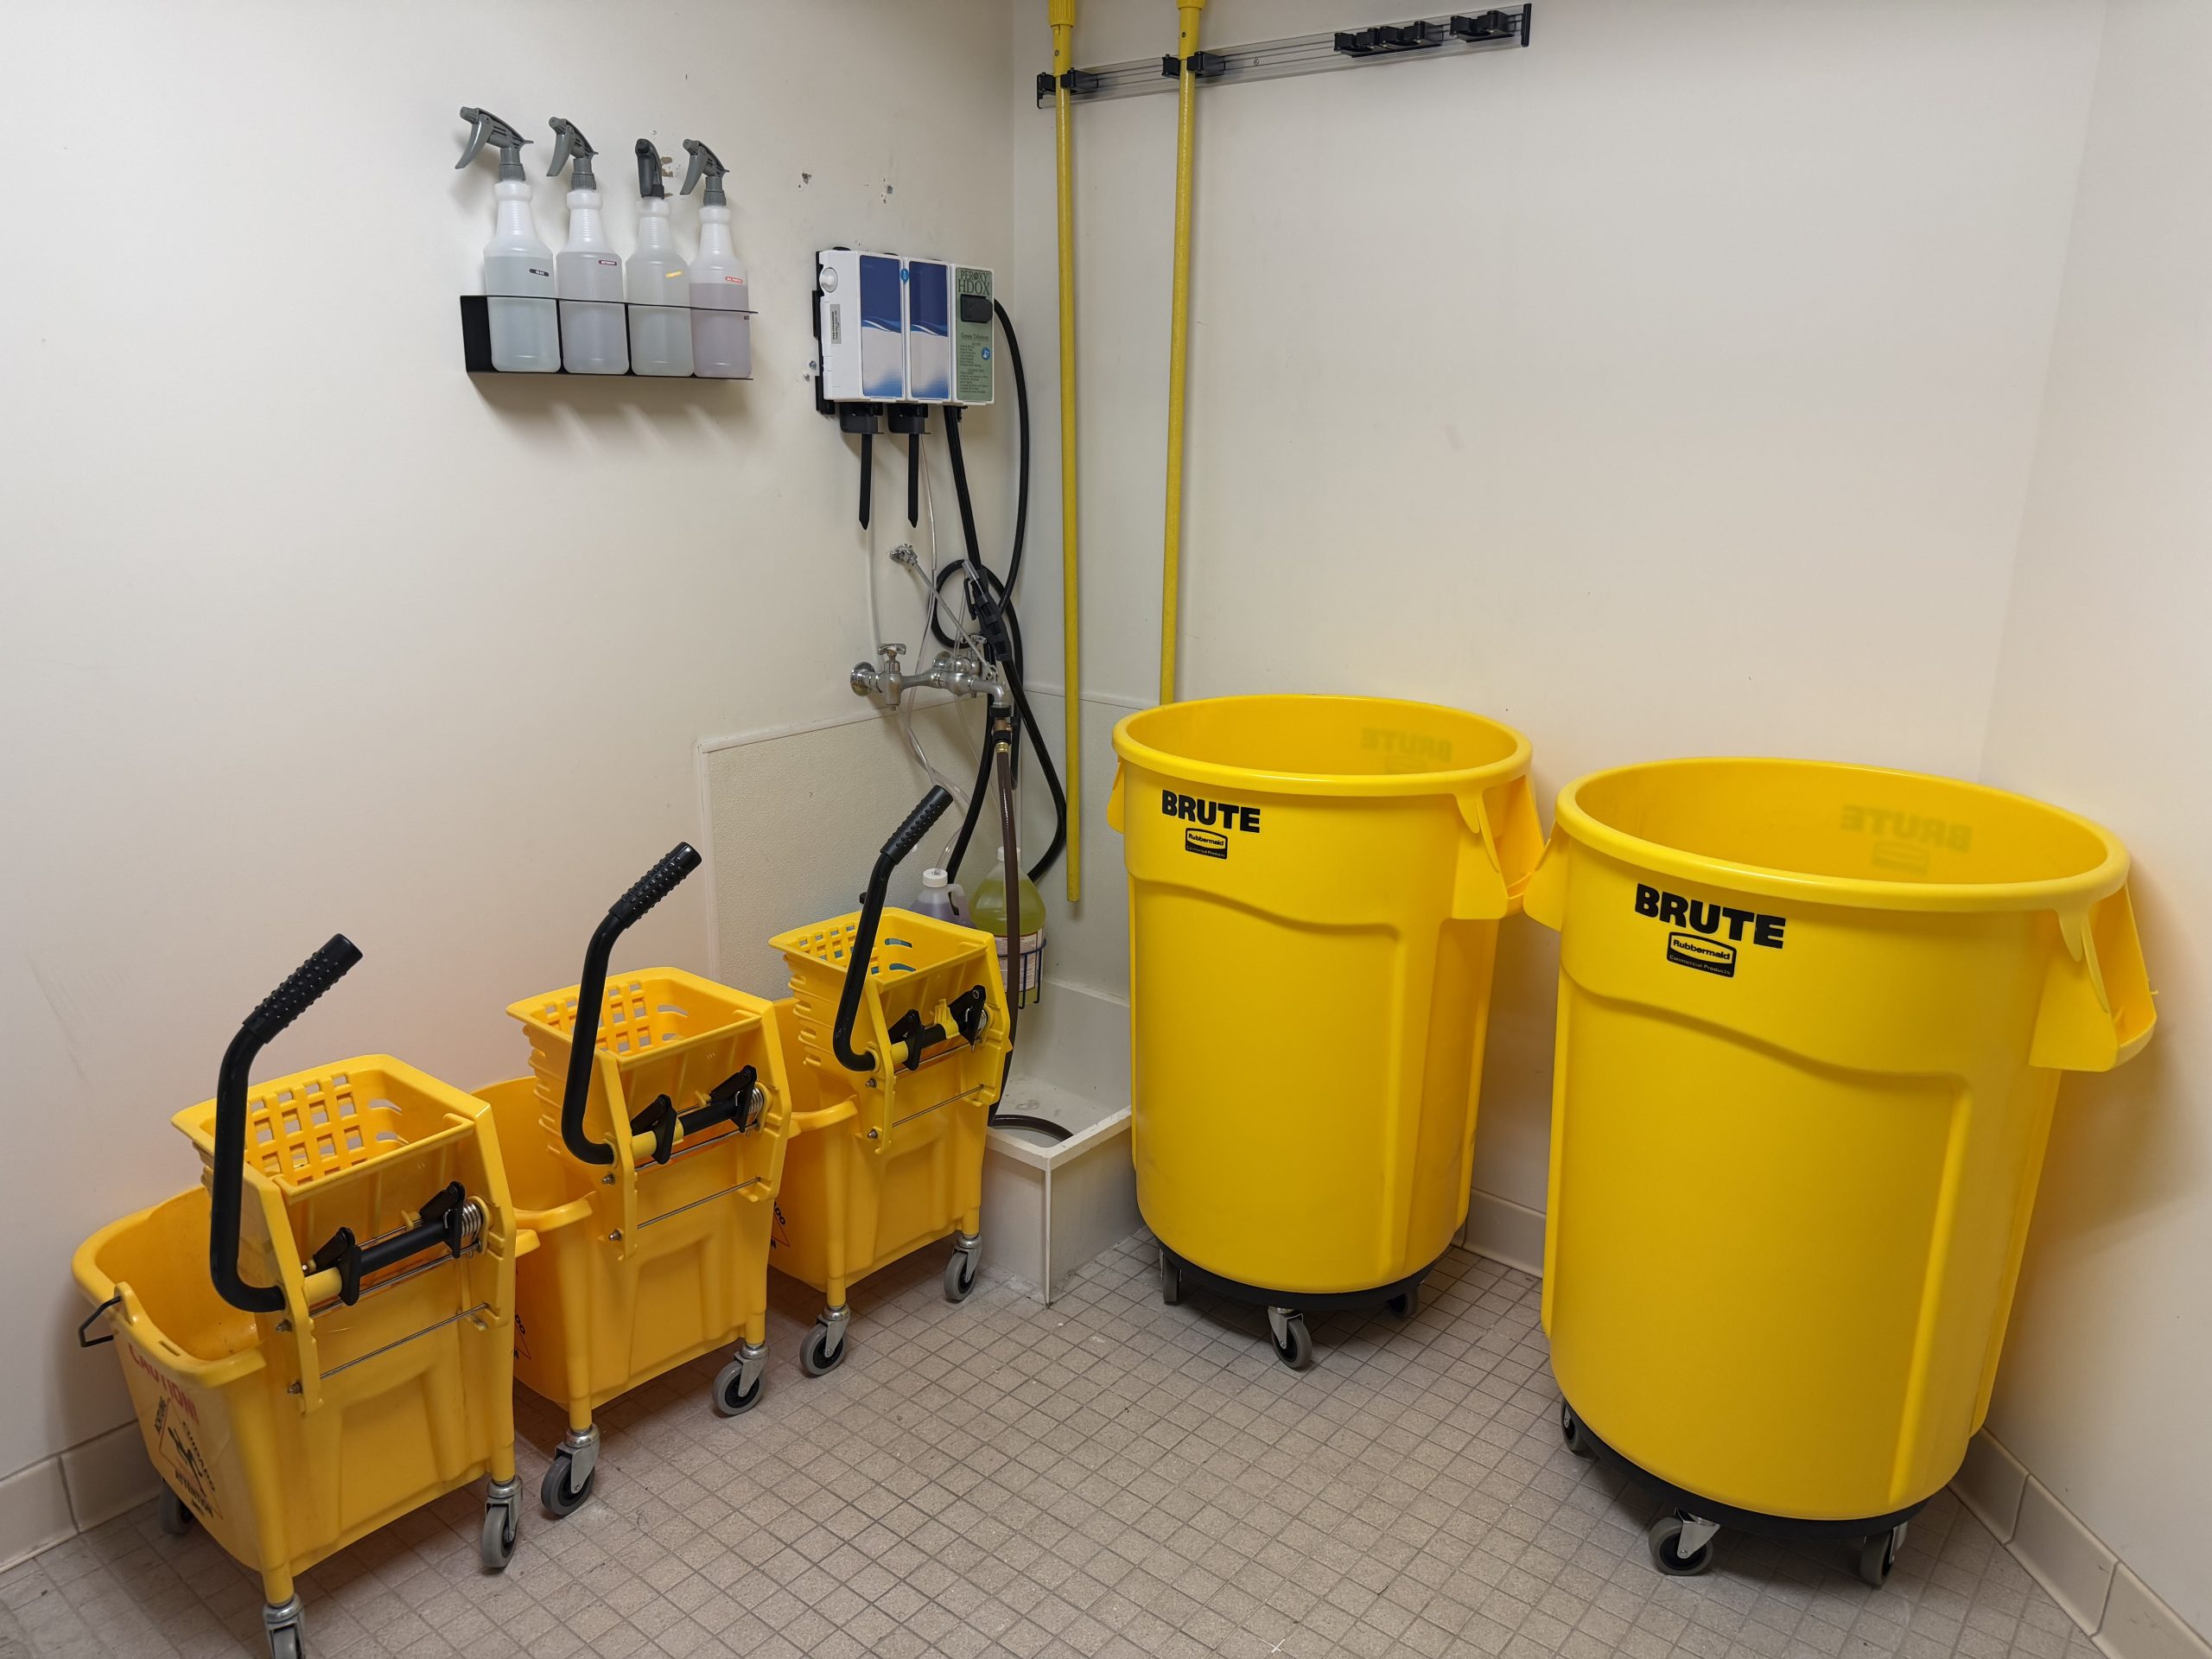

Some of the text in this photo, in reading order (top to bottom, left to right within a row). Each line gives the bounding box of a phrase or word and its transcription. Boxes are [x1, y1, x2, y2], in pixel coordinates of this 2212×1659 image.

[961, 270, 989, 282] PEROXY
[958, 278, 990, 296] HDOX
[1162, 789, 1261, 833] BRUTE
[1188, 833, 1224, 846] Rubbermaid
[1208, 849, 1225, 858] Products
[1635, 883, 1786, 949] BRUTE
[1673, 938, 1731, 960] Rubbermaid
[1669, 954, 1731, 976] Commercial Products
